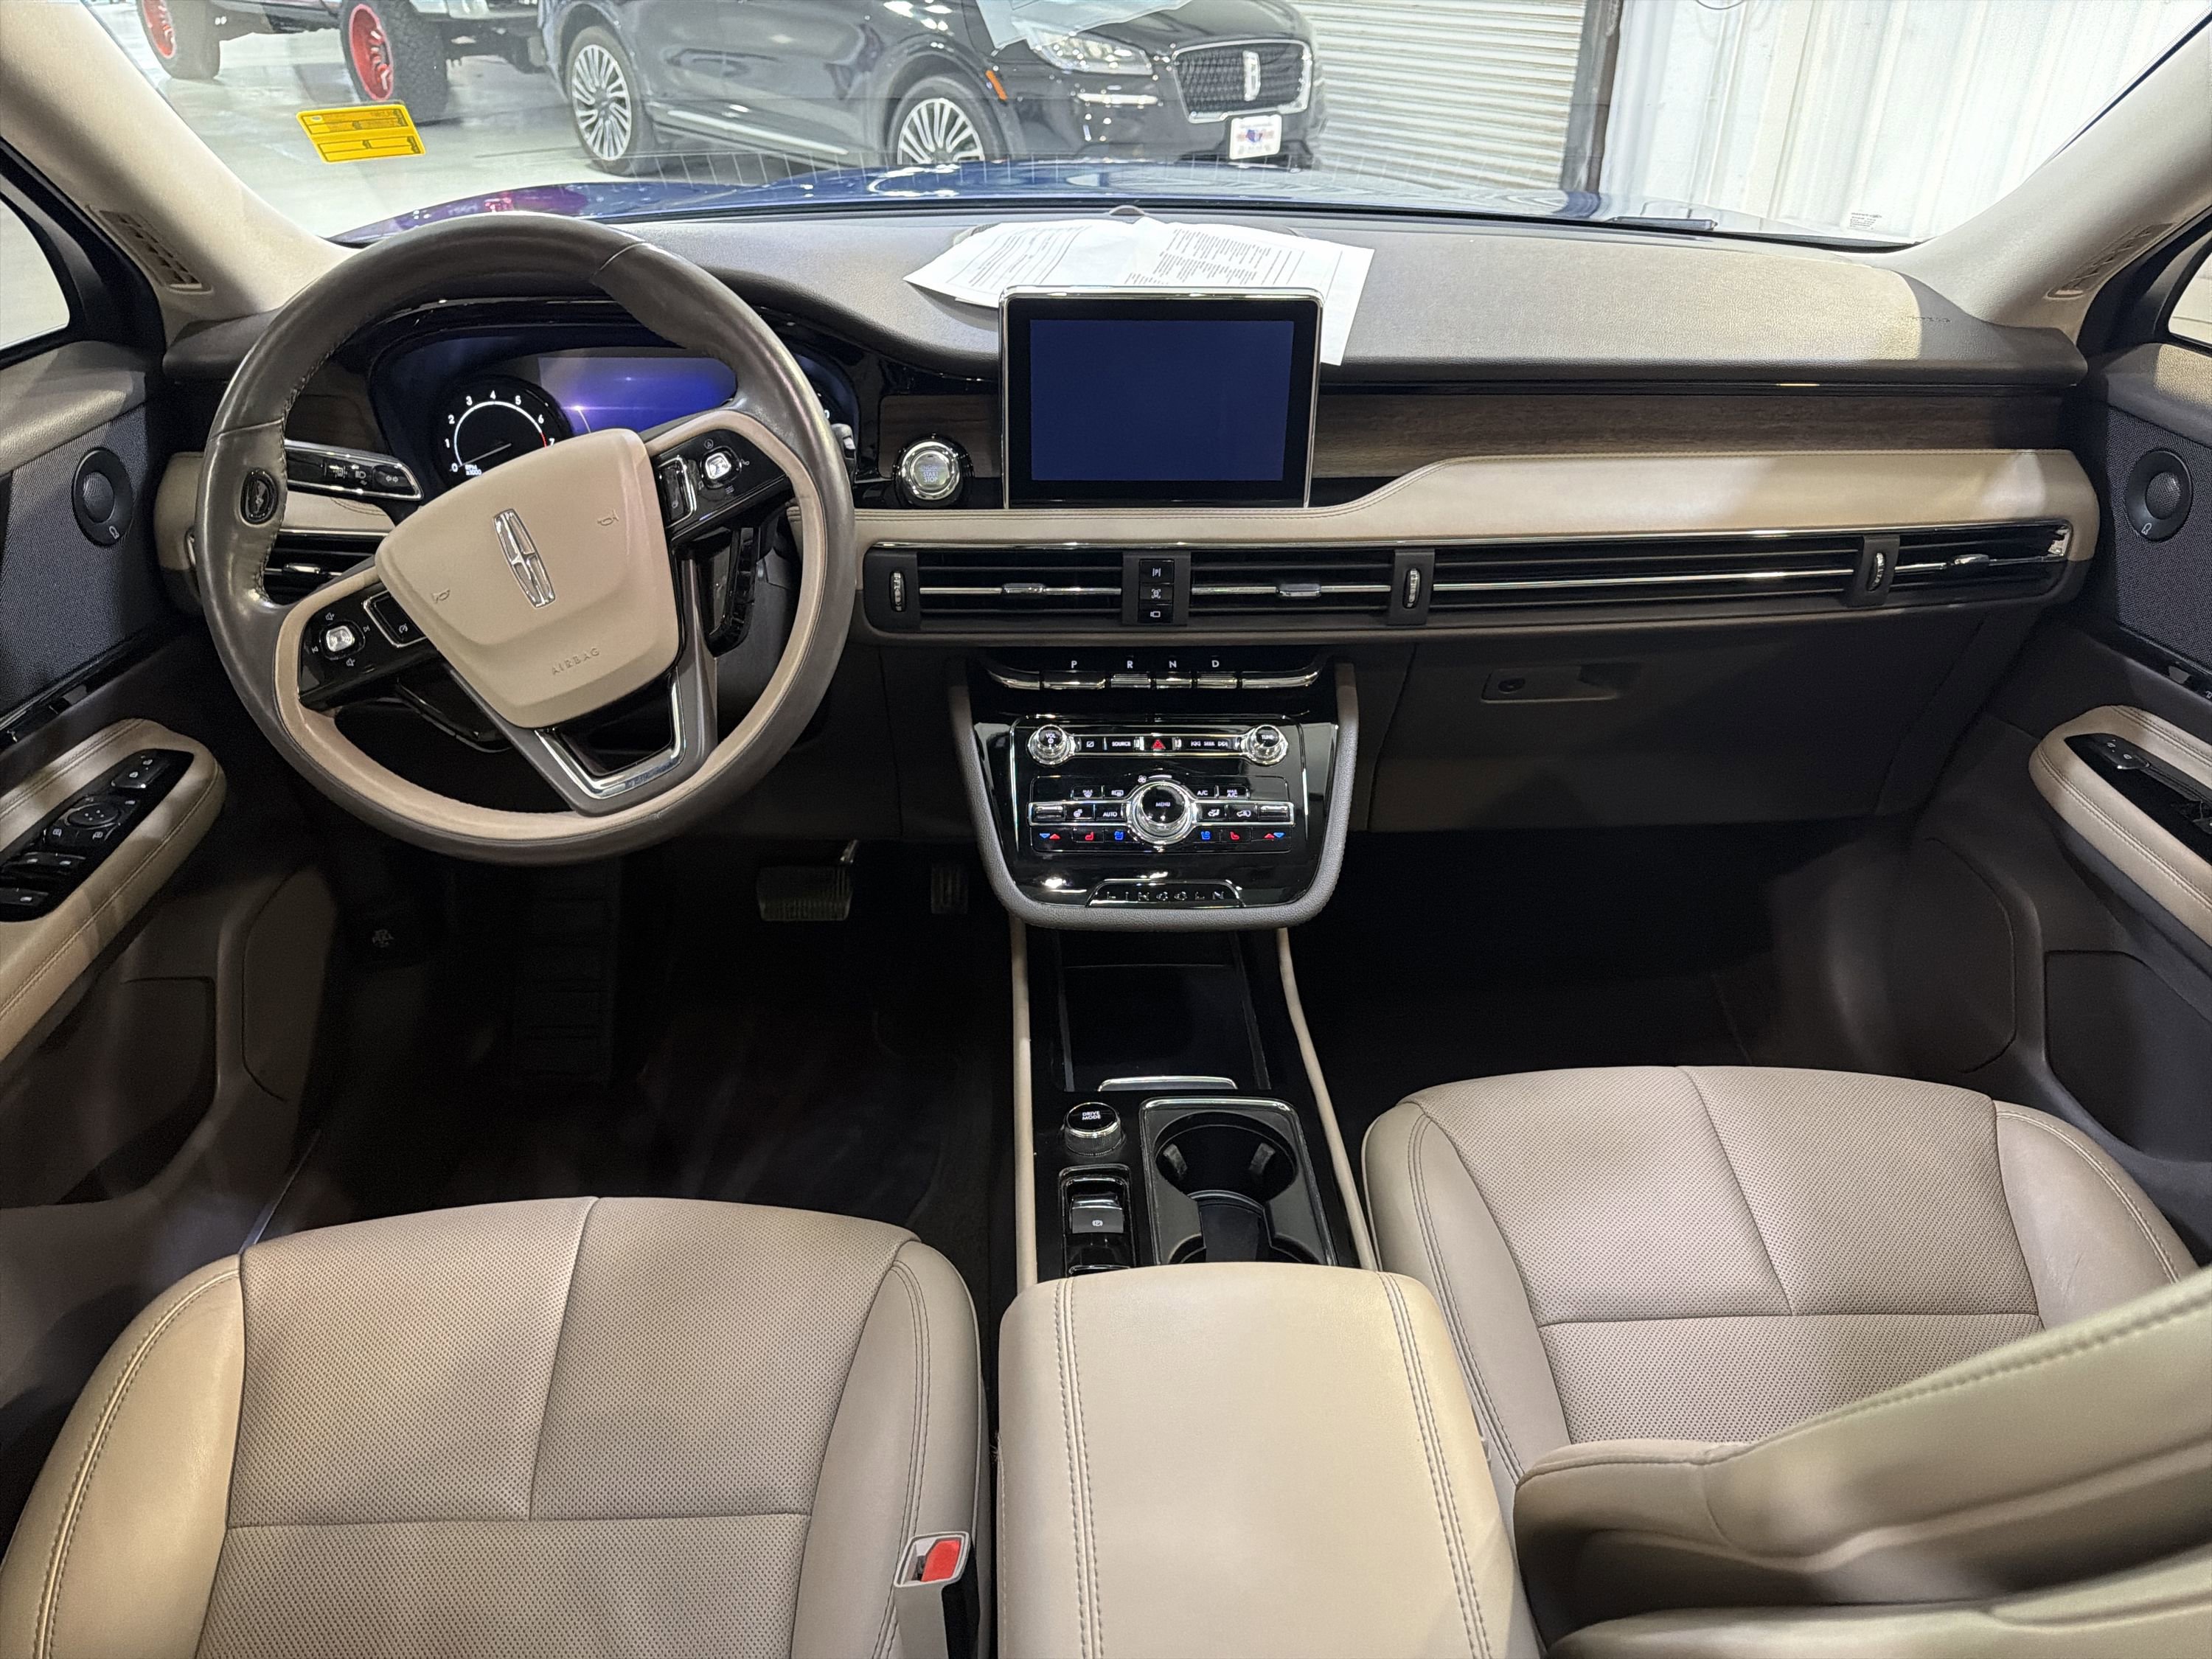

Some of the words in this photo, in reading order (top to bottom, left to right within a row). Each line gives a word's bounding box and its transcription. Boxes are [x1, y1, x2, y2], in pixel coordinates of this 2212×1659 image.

[490, 390, 496, 400] 4
[515, 395, 521, 405] 5
[466, 396, 473, 406] 3
[448, 414, 455, 424] 2
[538, 414, 544, 424] 6
[445, 438, 450, 448] 1
[549, 438, 555, 447] 7
[451, 462, 458, 473] 0
[552, 647, 600, 675] AIRBAG
[1071, 661, 1077, 669] P
[1127, 661, 1133, 669] R
[1107, 891, 1224, 901] LINCOLN
